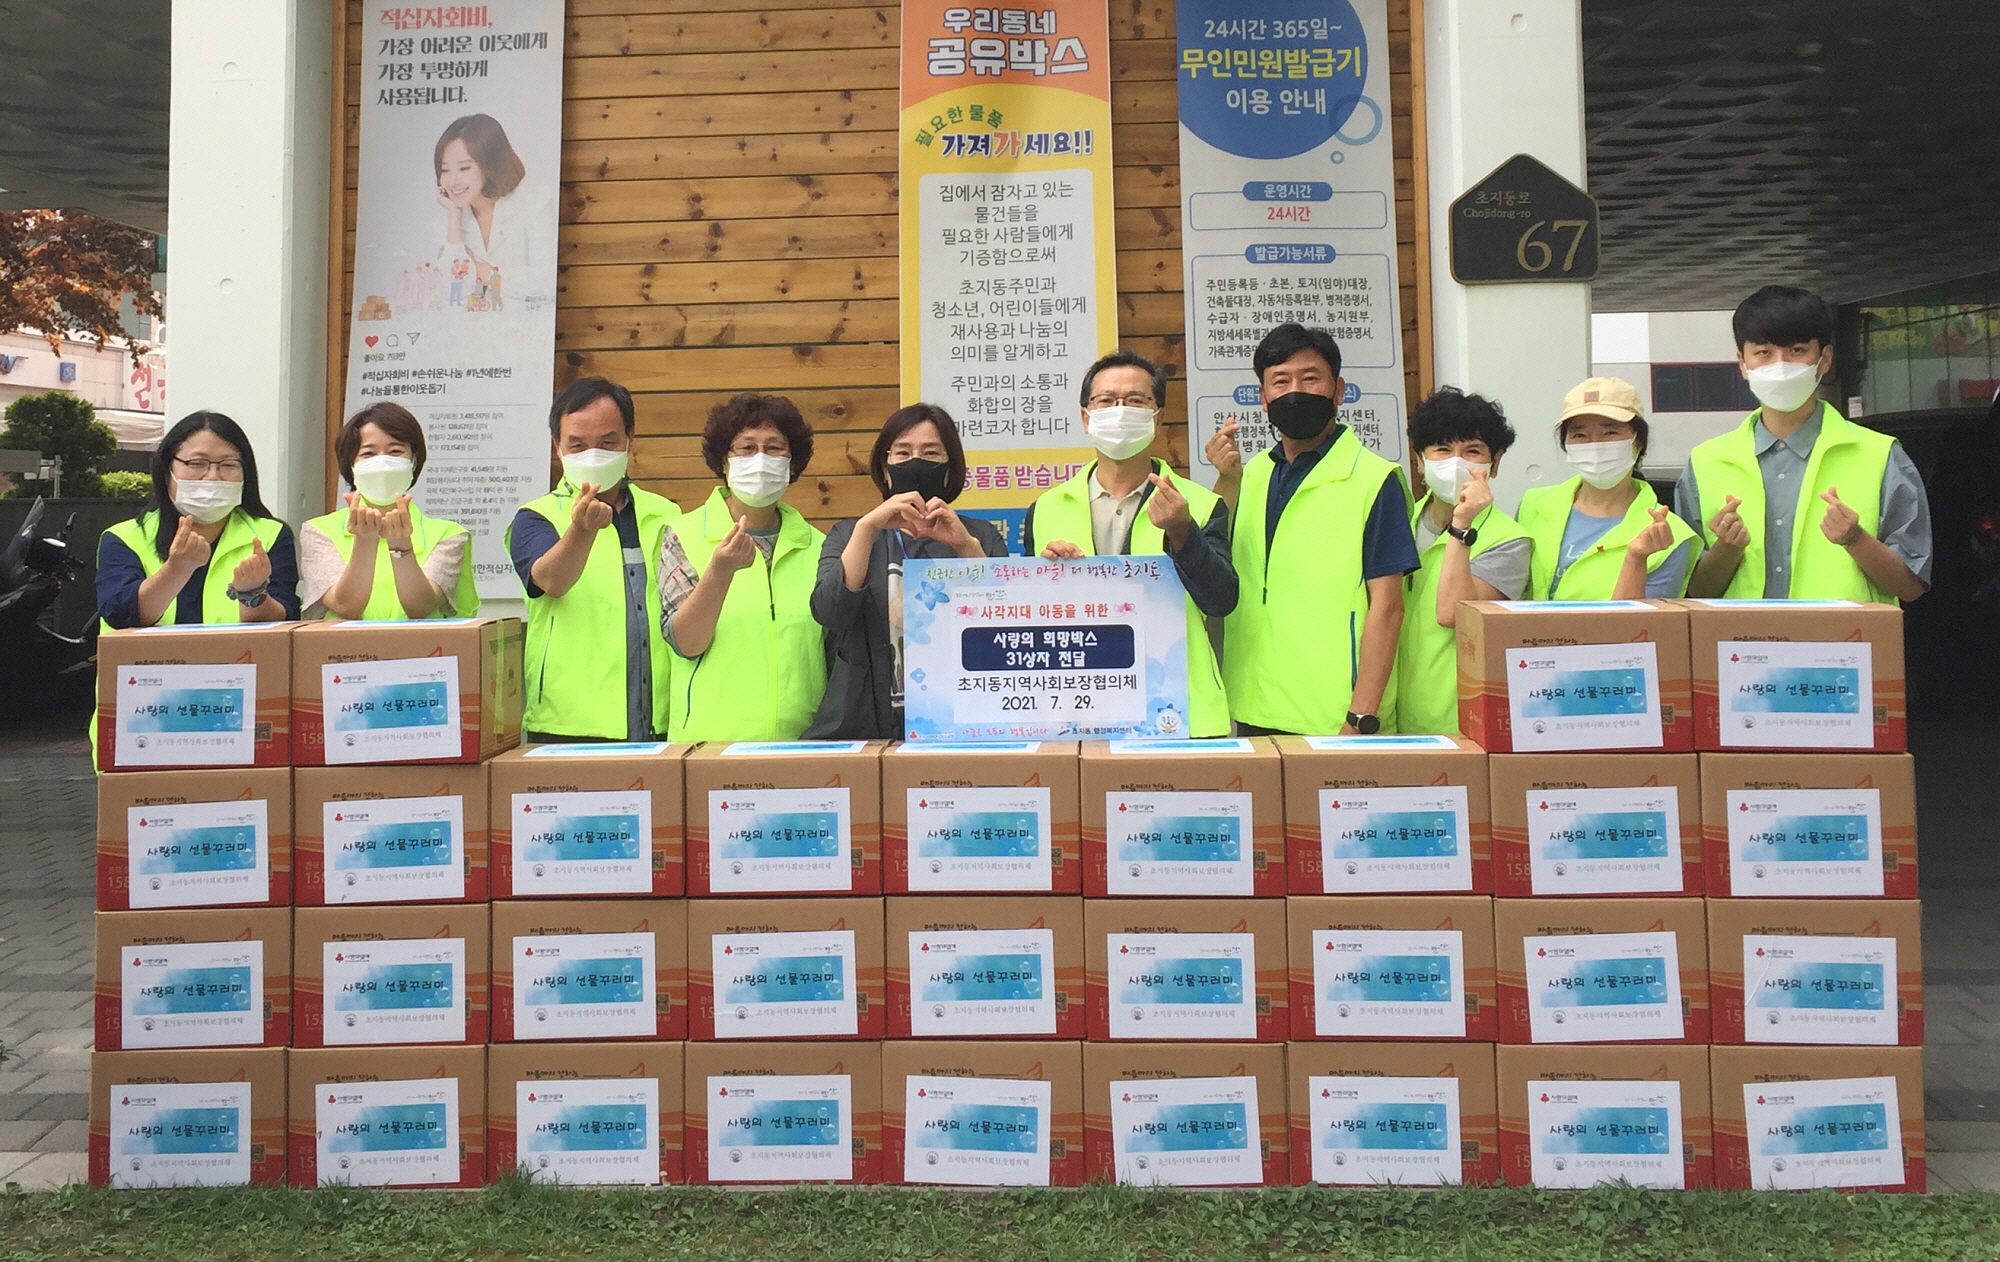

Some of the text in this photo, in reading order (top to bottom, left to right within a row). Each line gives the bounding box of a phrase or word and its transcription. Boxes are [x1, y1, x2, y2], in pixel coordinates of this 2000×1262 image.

[381, 6, 493, 30] 적십자회비,
[944, 8, 1057, 35] 우리동네
[1204, 18, 1342, 41] 24시간 365일~
[378, 32, 548, 56] 가장 어려운 이웃에게
[928, 36, 1089, 77] 공유박스
[1180, 46, 1362, 79] 무인민원발급기
[378, 60, 488, 81] 가장 투명하게
[376, 86, 468, 106] 사용됩니다.
[1226, 88, 1327, 115] 이용 안내
[914, 104, 1004, 148] 필요한 물품
[941, 130, 1093, 158] 가져가세요!!
[939, 181, 1074, 203] 집에서 잠자고 있는
[1264, 184, 1312, 199] 운영시간
[1475, 191, 1532, 207] 초지동로
[974, 204, 1039, 224] 물건들을
[1267, 206, 1311, 222] 24시간
[1463, 208, 1531, 220] Chojidong-ro
[942, 224, 1074, 246] 필요한 사람들에게
[1517, 220, 1589, 272] 67
[960, 246, 1057, 266] 기증함으로써
[1254, 246, 1327, 262] 발급가능서류
[959, 276, 1057, 296] 초지동주민과
[1206, 278, 1260, 292] 주민등록등
[932, 296, 1087, 320] 청소년, 어린이들에게
[1206, 295, 1256, 309] 건축물대장,
[1207, 310, 1374, 325] 수급자 장애인증명서, 농지원부,
[950, 320, 1068, 341] 재사용과 나눔의
[1208, 328, 1273, 341] 지방세세목별과
[364, 352, 386, 363] 좋아요
[950, 341, 1069, 363] 의미를 알게하고
[362, 367, 512, 381] #적십자회비 #손쉬운나눔 #1년에한번
[361, 384, 446, 396] #나눔을통한이웃돕기
[950, 372, 1069, 393] 주민과의 소통과
[967, 394, 1053, 415] 화합의 장을
[954, 416, 1070, 438] 마련코자 합니다
[474, 563, 515, 575] 한적십자
[1072, 565, 1082, 574] 더
[1124, 560, 1161, 580] 초지동
[982, 604, 1109, 619] 사각지대 아동을 위한
[994, 631, 1098, 647] 사랑의 희망박스
[1006, 651, 1086, 668] 31상자 전달
[958, 674, 1137, 692] 초지동지역사회보장협의체
[1740, 684, 1852, 696] 사랑의 선물꾸러미
[1529, 686, 1639, 701] 사랑의 선물꾸러미
[135, 704, 238, 717] 사랑의 선물꾸러미
[341, 699, 443, 714] 사랑의 선물꾸러미
[1002, 696, 1094, 711] 2021. 7. 29.
[531, 831, 634, 844] 사랑의 선물꾸러미
[729, 828, 832, 842] 사랑의 선물꾸러미
[927, 828, 1032, 841] 사랑의 선물꾸러미
[1127, 832, 1234, 846] 사랑의 선물꾸러미
[1342, 826, 1450, 841] 사랑의 선물꾸러미
[1550, 829, 1660, 842] 사랑의 선물꾸러미
[1749, 832, 1861, 845] 사랑의 선물꾸러미
[147, 843, 250, 857] 사랑의 선물꾸러미
[343, 835, 446, 853] 사랑의 선물꾸러미
[533, 975, 637, 989] 사랑의 선물꾸러미
[733, 973, 837, 986] 사랑의 선물꾸러미
[930, 971, 1035, 984] 사랑의 선물꾸러미
[1129, 974, 1236, 987] 사랑의 선물꾸러미
[1335, 972, 1444, 984] 사랑의 선물꾸러미
[1548, 975, 1659, 989] 사랑의 선물꾸러미
[141, 981, 244, 998] 사랑의 선물꾸러미
[343, 980, 447, 995] 사랑의 선물꾸러미
[1765, 979, 1877, 993] 사랑의 선물꾸러미
[336, 1121, 440, 1136] 사랑의 선물꾸러미
[536, 1121, 640, 1135] 사랑의 선물꾸러미
[728, 1116, 833, 1129] 사랑의 선물꾸러미
[925, 1120, 1032, 1136] 사랑의 선물꾸러미
[1132, 1121, 1240, 1135] 사랑의 선물꾸러미
[1331, 1119, 1439, 1133] 사랑의 선물꾸러미
[1550, 1124, 1662, 1136] 사랑의 선물꾸러미
[1768, 1122, 1880, 1137] 사랑의 선물꾸러미
[129, 1125, 233, 1138] 사랑의 선물꾸러미
